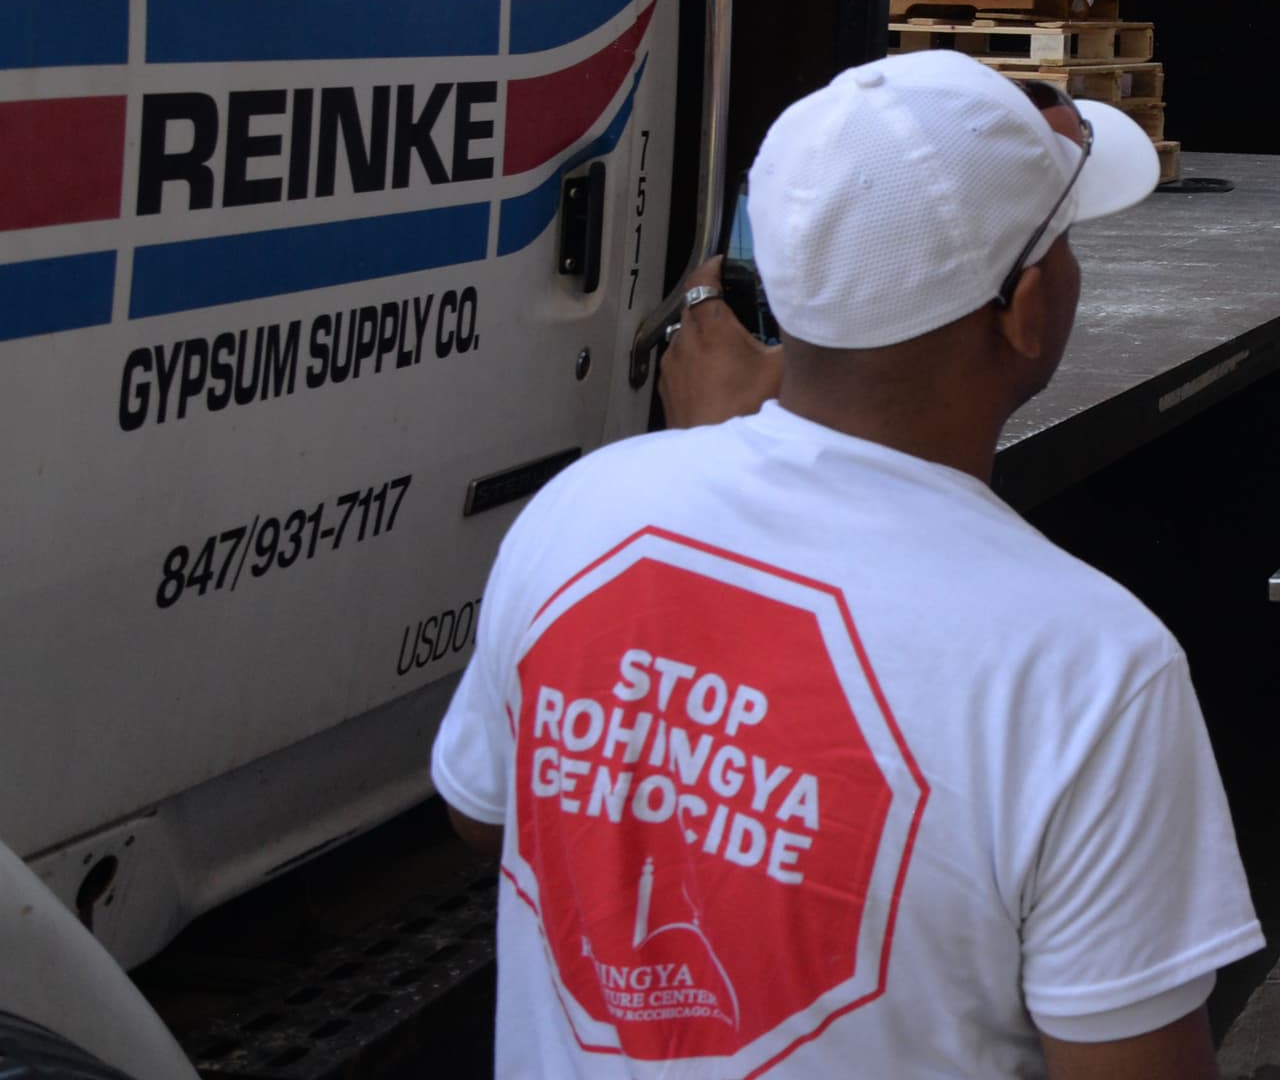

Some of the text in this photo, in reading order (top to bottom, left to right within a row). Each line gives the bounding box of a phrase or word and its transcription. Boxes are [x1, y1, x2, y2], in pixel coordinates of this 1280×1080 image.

[136, 80, 498, 216] REINKE
[118, 286, 480, 432] GYPSUM SUPPLY CO.
[155, 475, 413, 609] 847/931-7117
[534, 685, 820, 831] ROHINGYA
[612, 649, 768, 736] STOP
[531, 746, 813, 885] GENOCIDE
